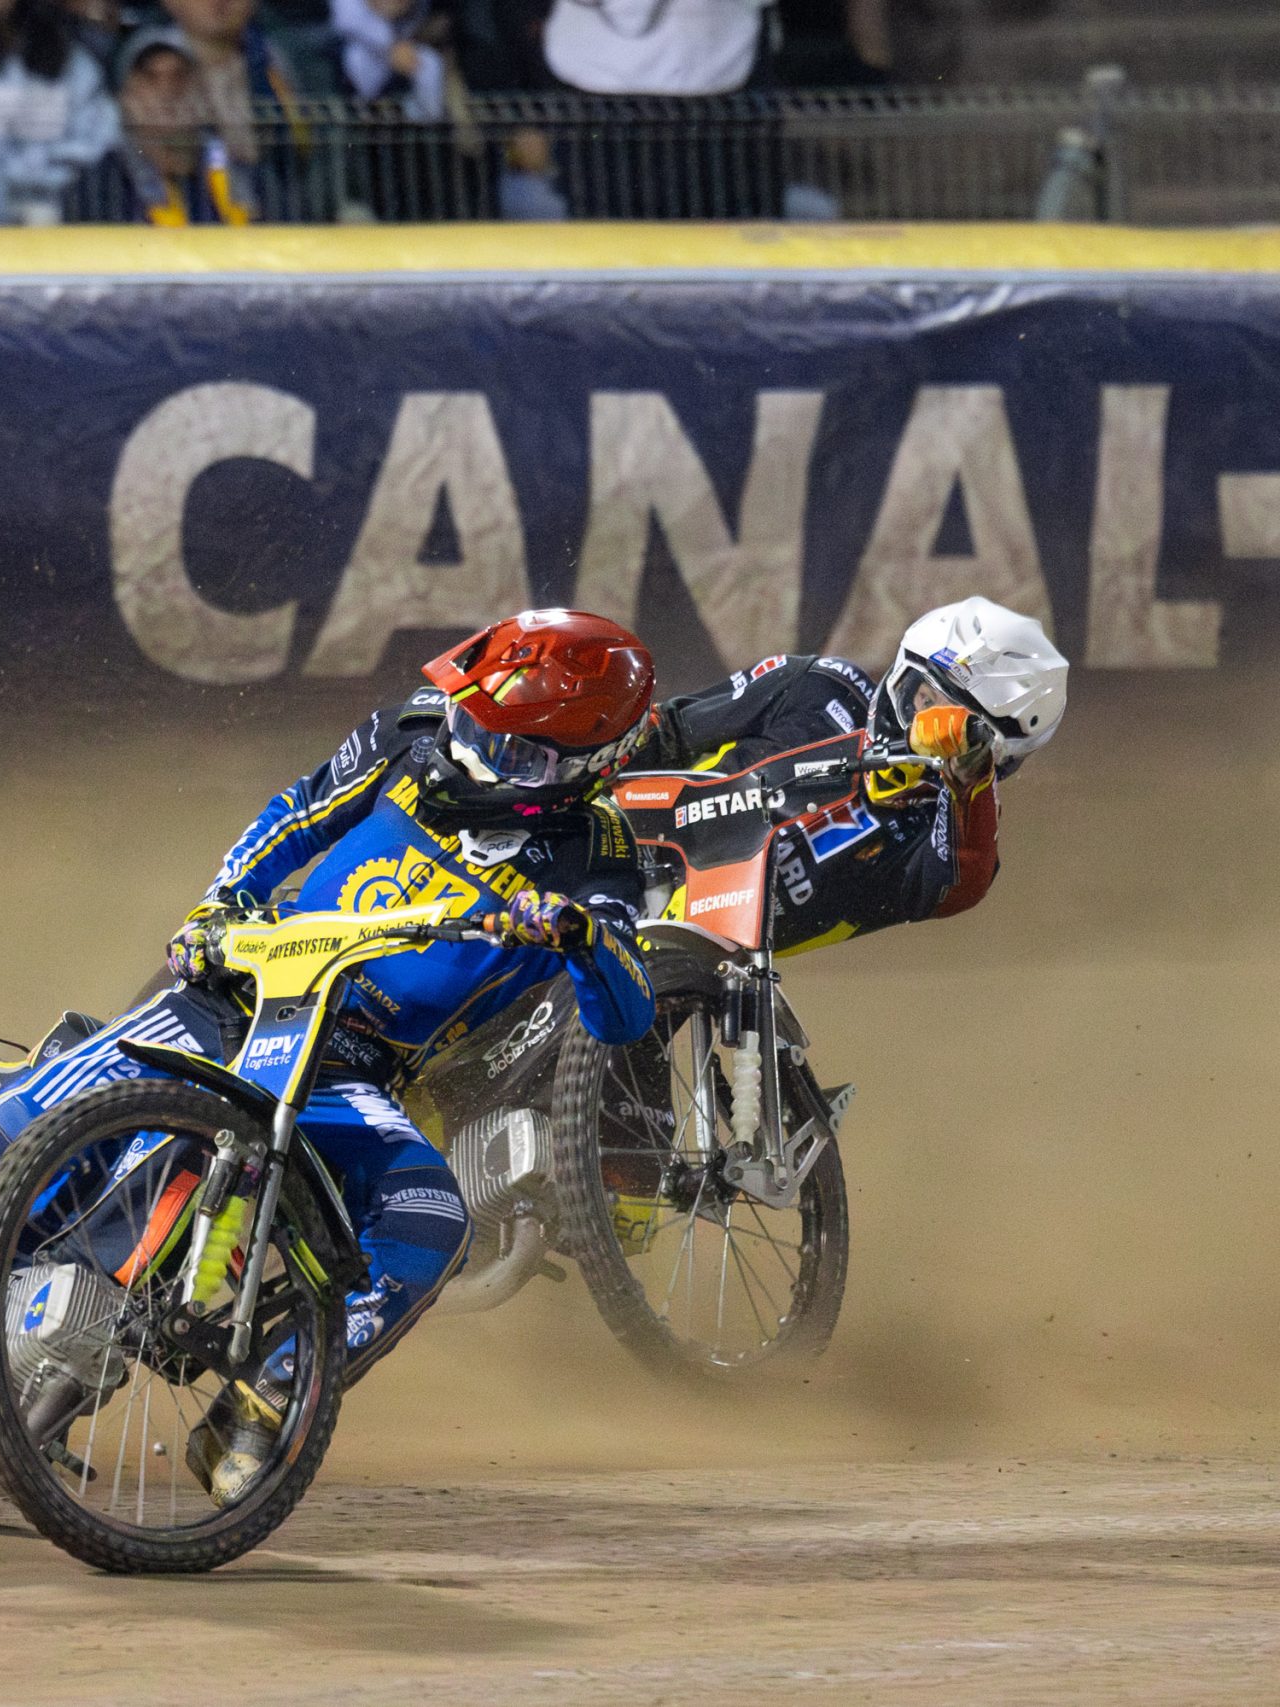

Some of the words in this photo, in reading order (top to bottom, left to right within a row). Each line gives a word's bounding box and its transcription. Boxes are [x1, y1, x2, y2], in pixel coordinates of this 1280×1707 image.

[688, 788, 786, 824] BETARD
[690, 888, 756, 916] BECKHOFF
[250, 1035, 299, 1057] DPV
[245, 1054, 290, 1070] logistic
